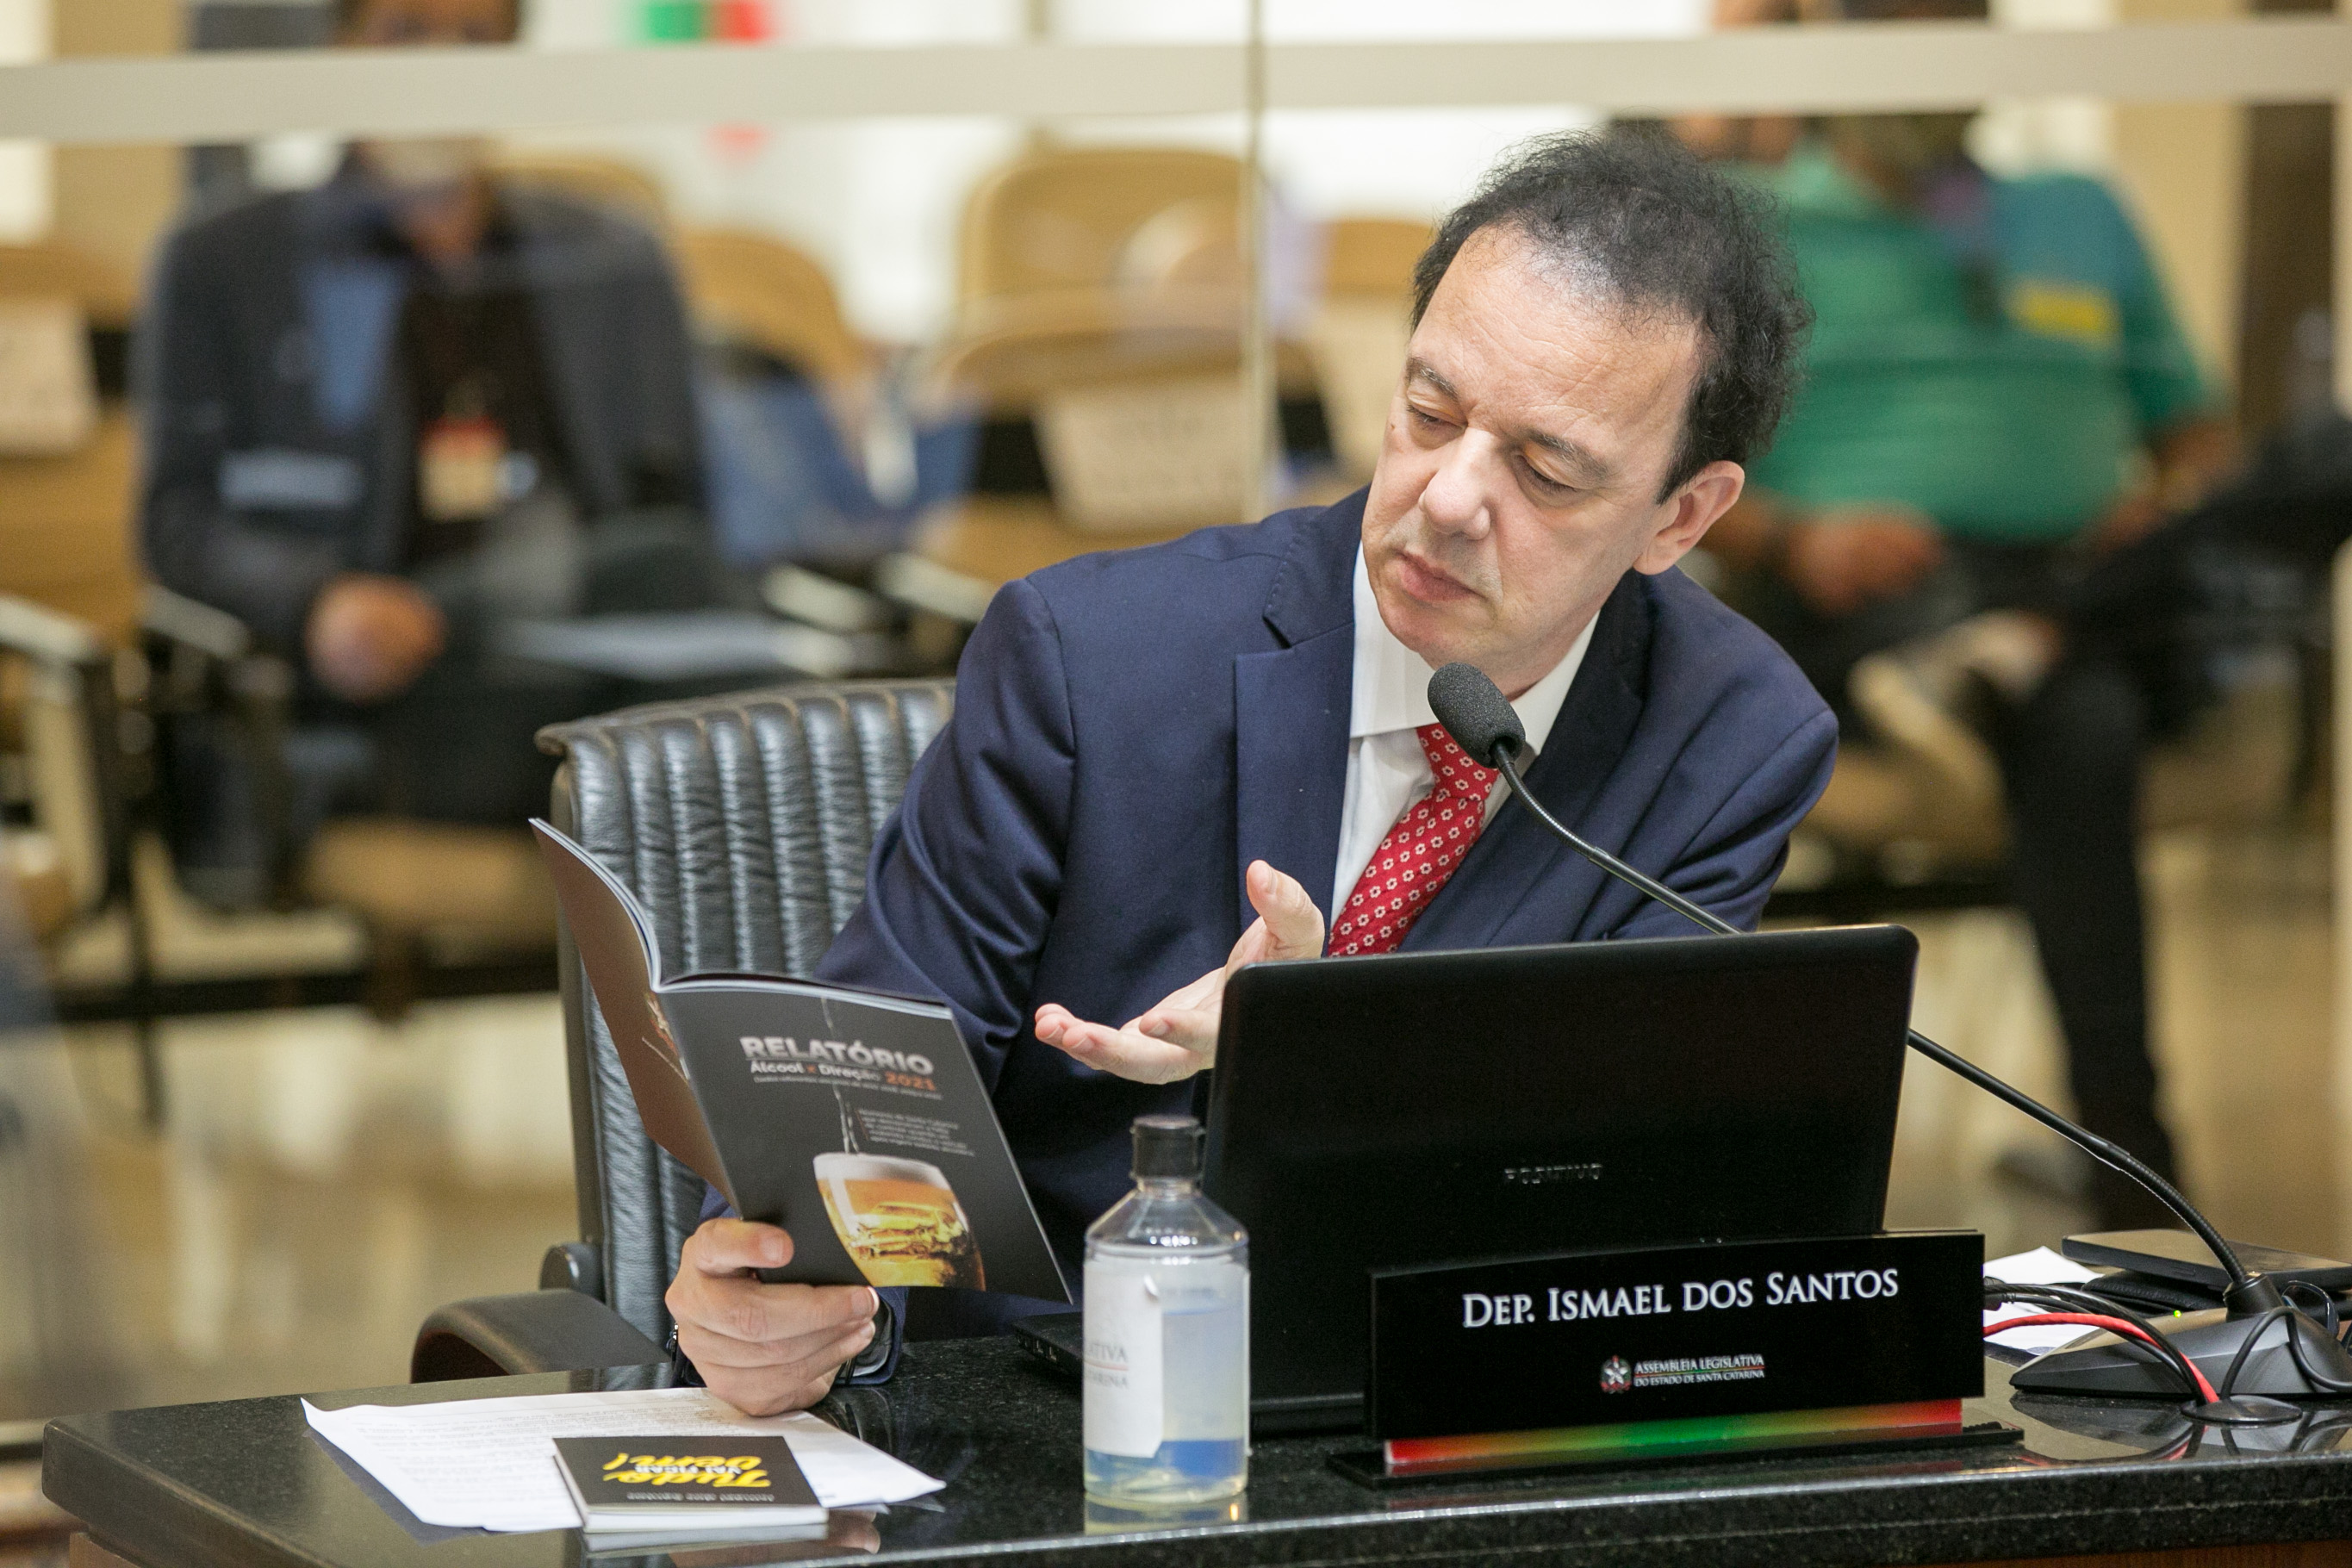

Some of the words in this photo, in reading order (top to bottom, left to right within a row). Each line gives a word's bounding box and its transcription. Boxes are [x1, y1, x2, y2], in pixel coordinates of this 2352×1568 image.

[739, 1036, 934, 1075] RELATÓRIO
[885, 1071, 936, 1092] 2021
[1635, 1359, 1697, 1373] ASSEMBLEIA
[1699, 1354, 1764, 1368] LEGISLATIVA
[1633, 1377, 1649, 1387] DO
[1651, 1374, 1682, 1386] ESTADO
[1683, 1373, 1696, 1384] DE
[1697, 1372, 1723, 1384] SANTA
[1723, 1370, 1765, 1381] CATARINA
